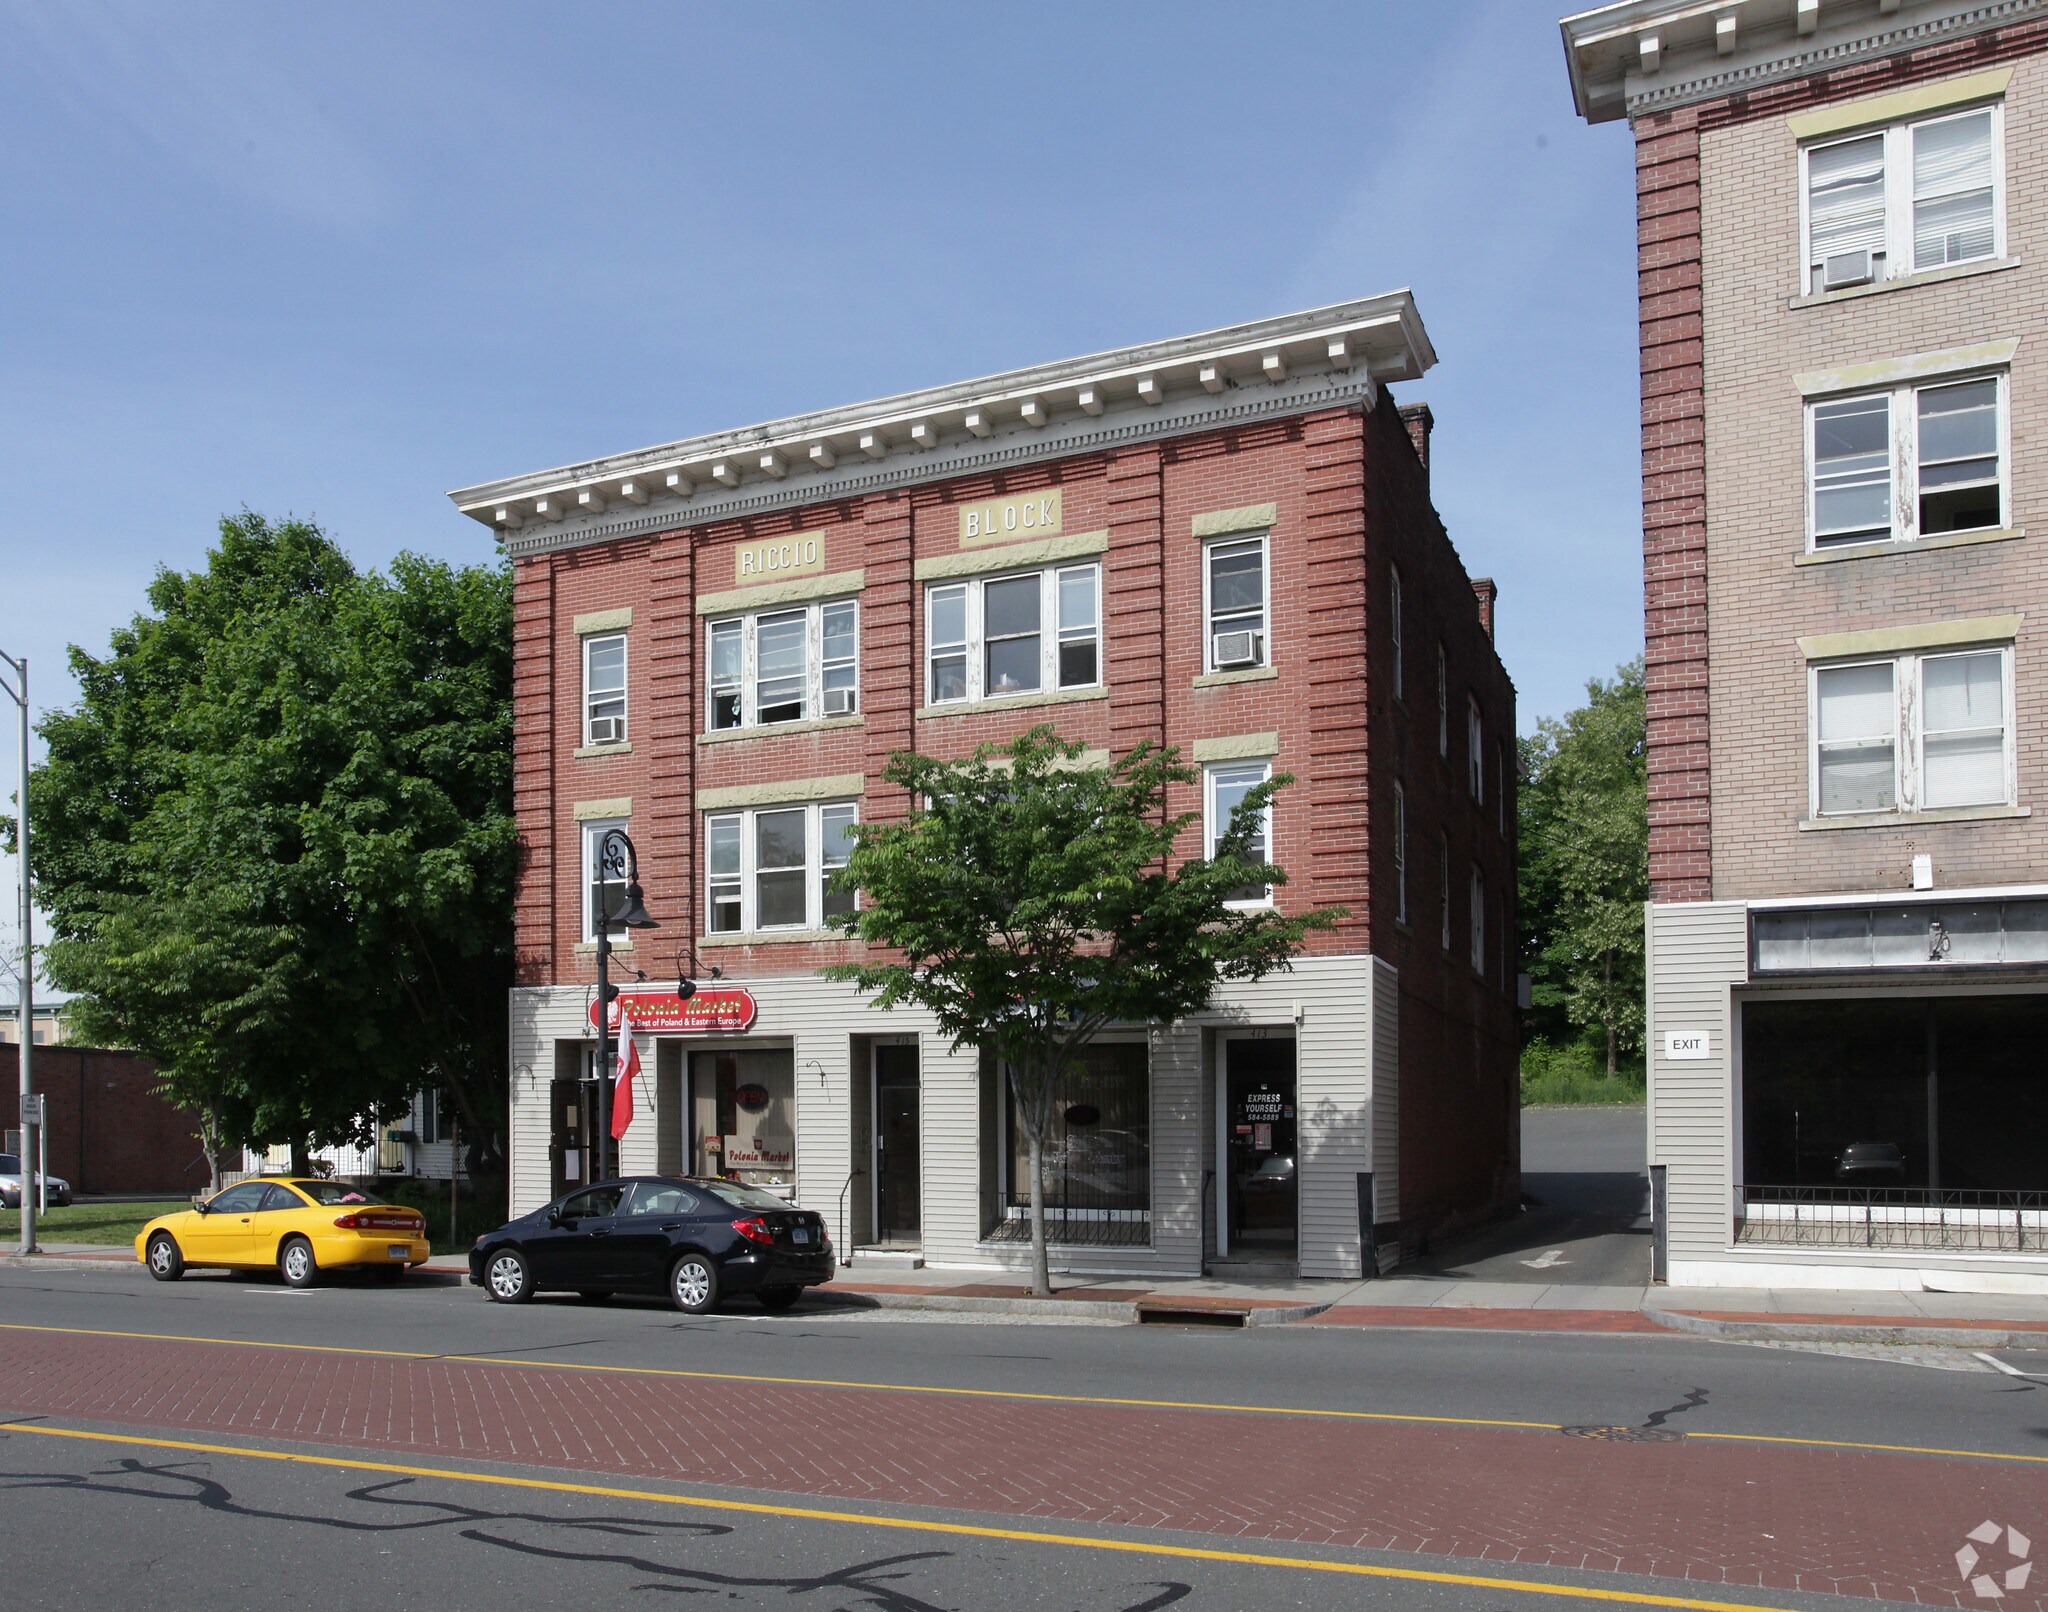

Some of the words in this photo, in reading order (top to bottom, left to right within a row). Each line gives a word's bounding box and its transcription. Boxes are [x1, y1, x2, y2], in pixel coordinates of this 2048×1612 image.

[966, 498, 1055, 538] BLOCK
[742, 540, 817, 575] RICCIO
[623, 999, 679, 1016] Polonia
[686, 996, 741, 1015] Market
[636, 1019, 652, 1027] Best
[652, 1018, 661, 1026] of
[661, 1018, 683, 1026] Poland
[684, 1017, 690, 1025] &
[691, 1016, 716, 1025] Eastern
[717, 1016, 741, 1026] Europe
[1250, 1029, 1267, 1039] 413
[1673, 1039, 1701, 1050] EXIT
[1247, 1094, 1281, 1103] EXPRESS
[1245, 1104, 1282, 1113] YOURSELF
[729, 1149, 759, 1162] Polonia
[762, 1150, 790, 1163] Market
